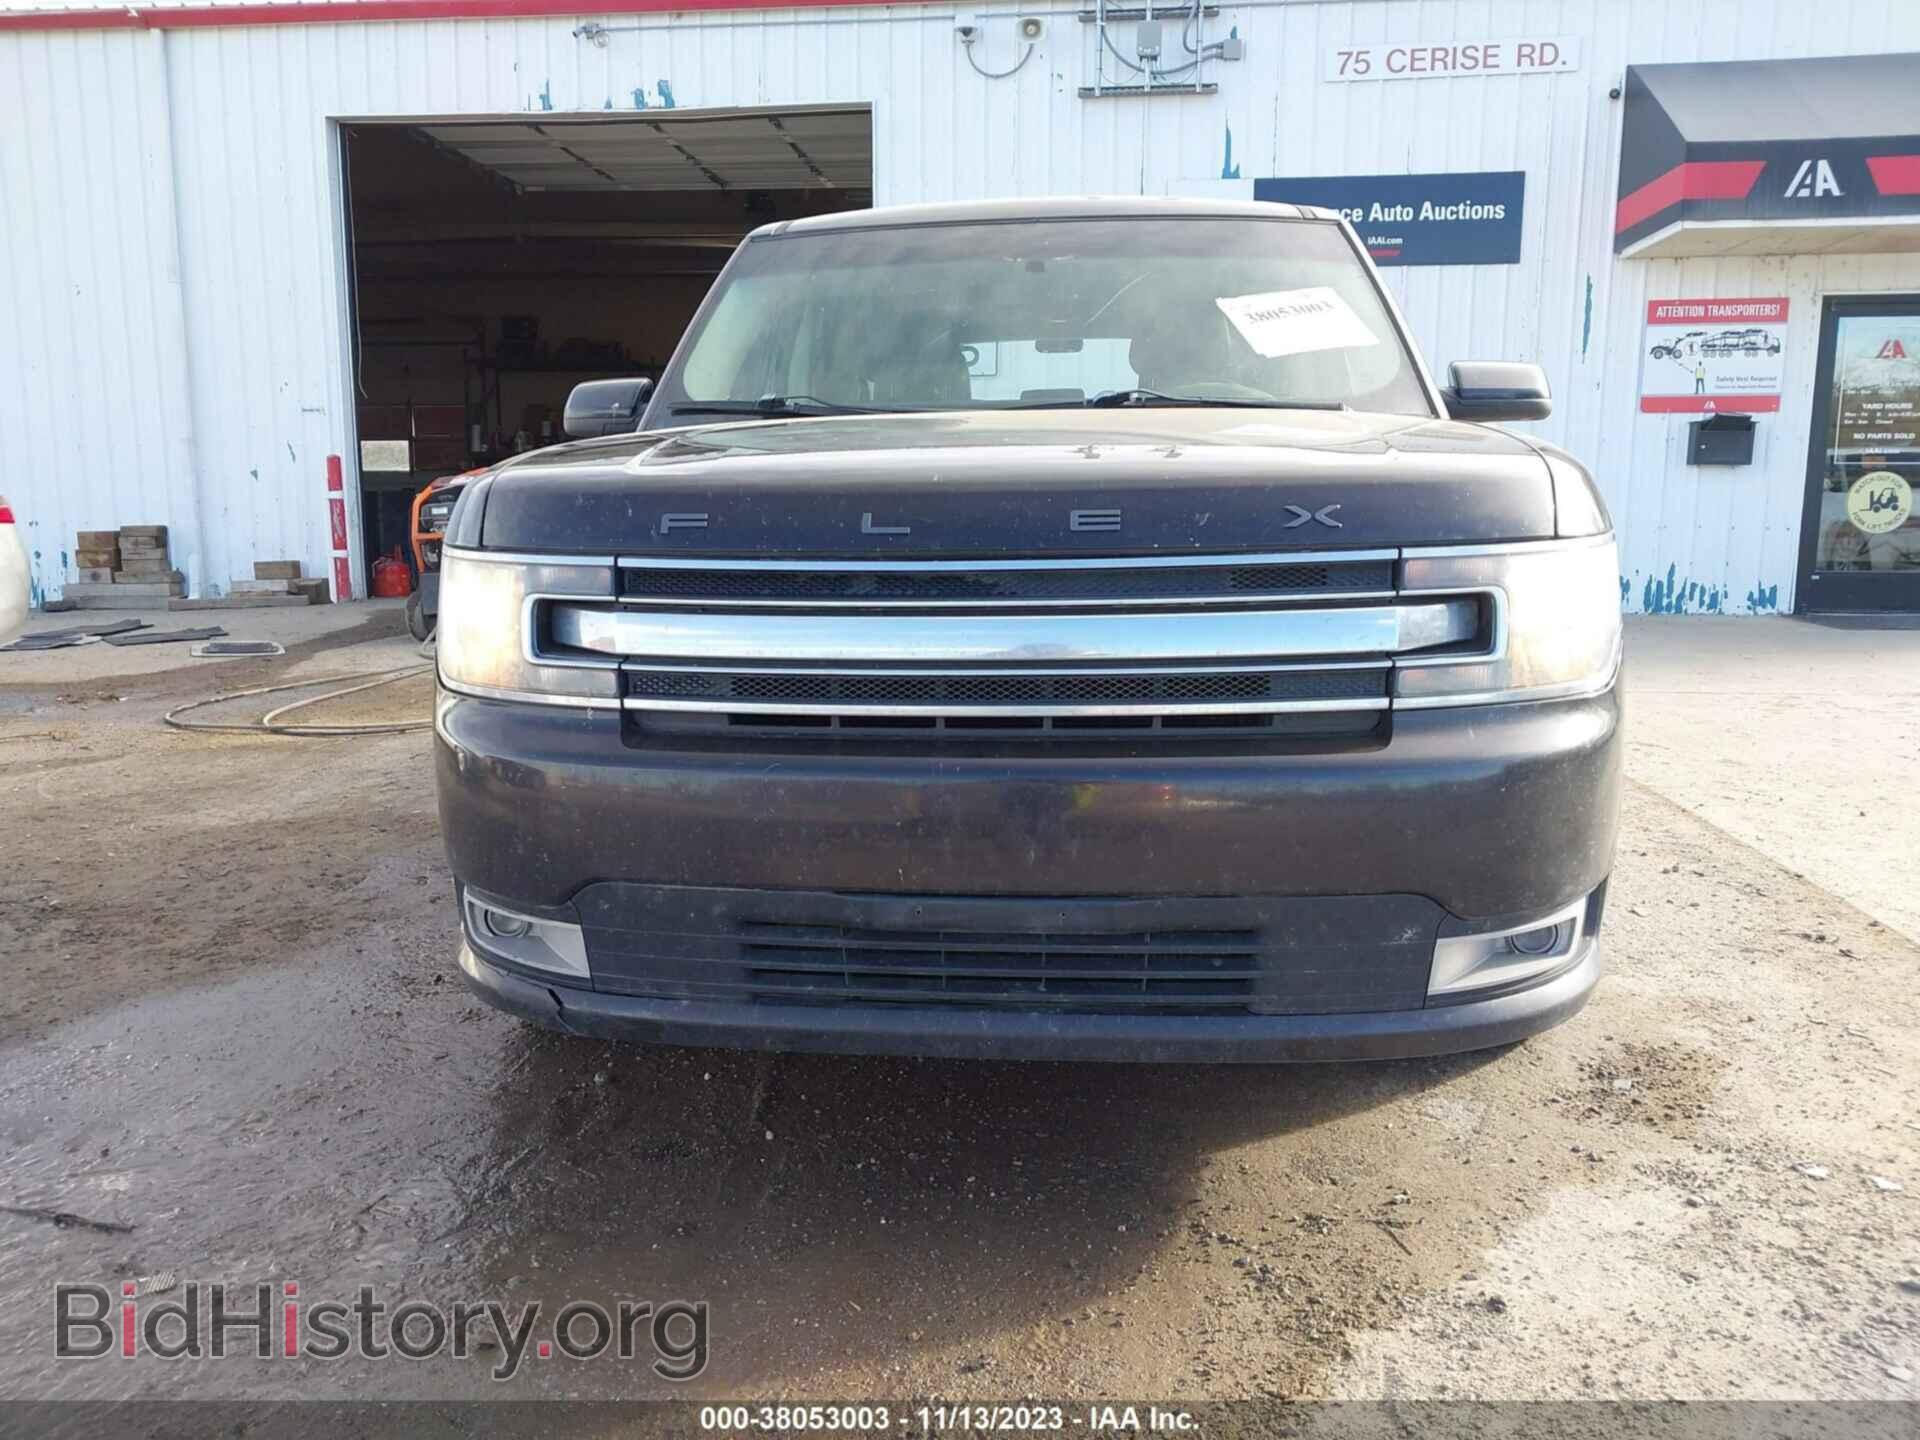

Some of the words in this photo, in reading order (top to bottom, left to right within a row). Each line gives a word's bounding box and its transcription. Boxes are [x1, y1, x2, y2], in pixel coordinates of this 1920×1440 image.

[1336, 50, 1371, 76] 75
[1386, 44, 1501, 74] CERISE
[1516, 42, 1567, 68] RD.
[1368, 202, 1414, 222] Auto
[1419, 200, 1506, 221] Auctions
[1656, 305, 1706, 318] ATTENTION
[1707, 303, 1781, 317] TRANSPORTERS!
[1862, 402, 1884, 410] YARD
[1885, 402, 1914, 410] HOURS
[1853, 432, 1866, 440] NO
[1867, 432, 1893, 440] PARTS
[1894, 432, 1917, 440] SOLD
